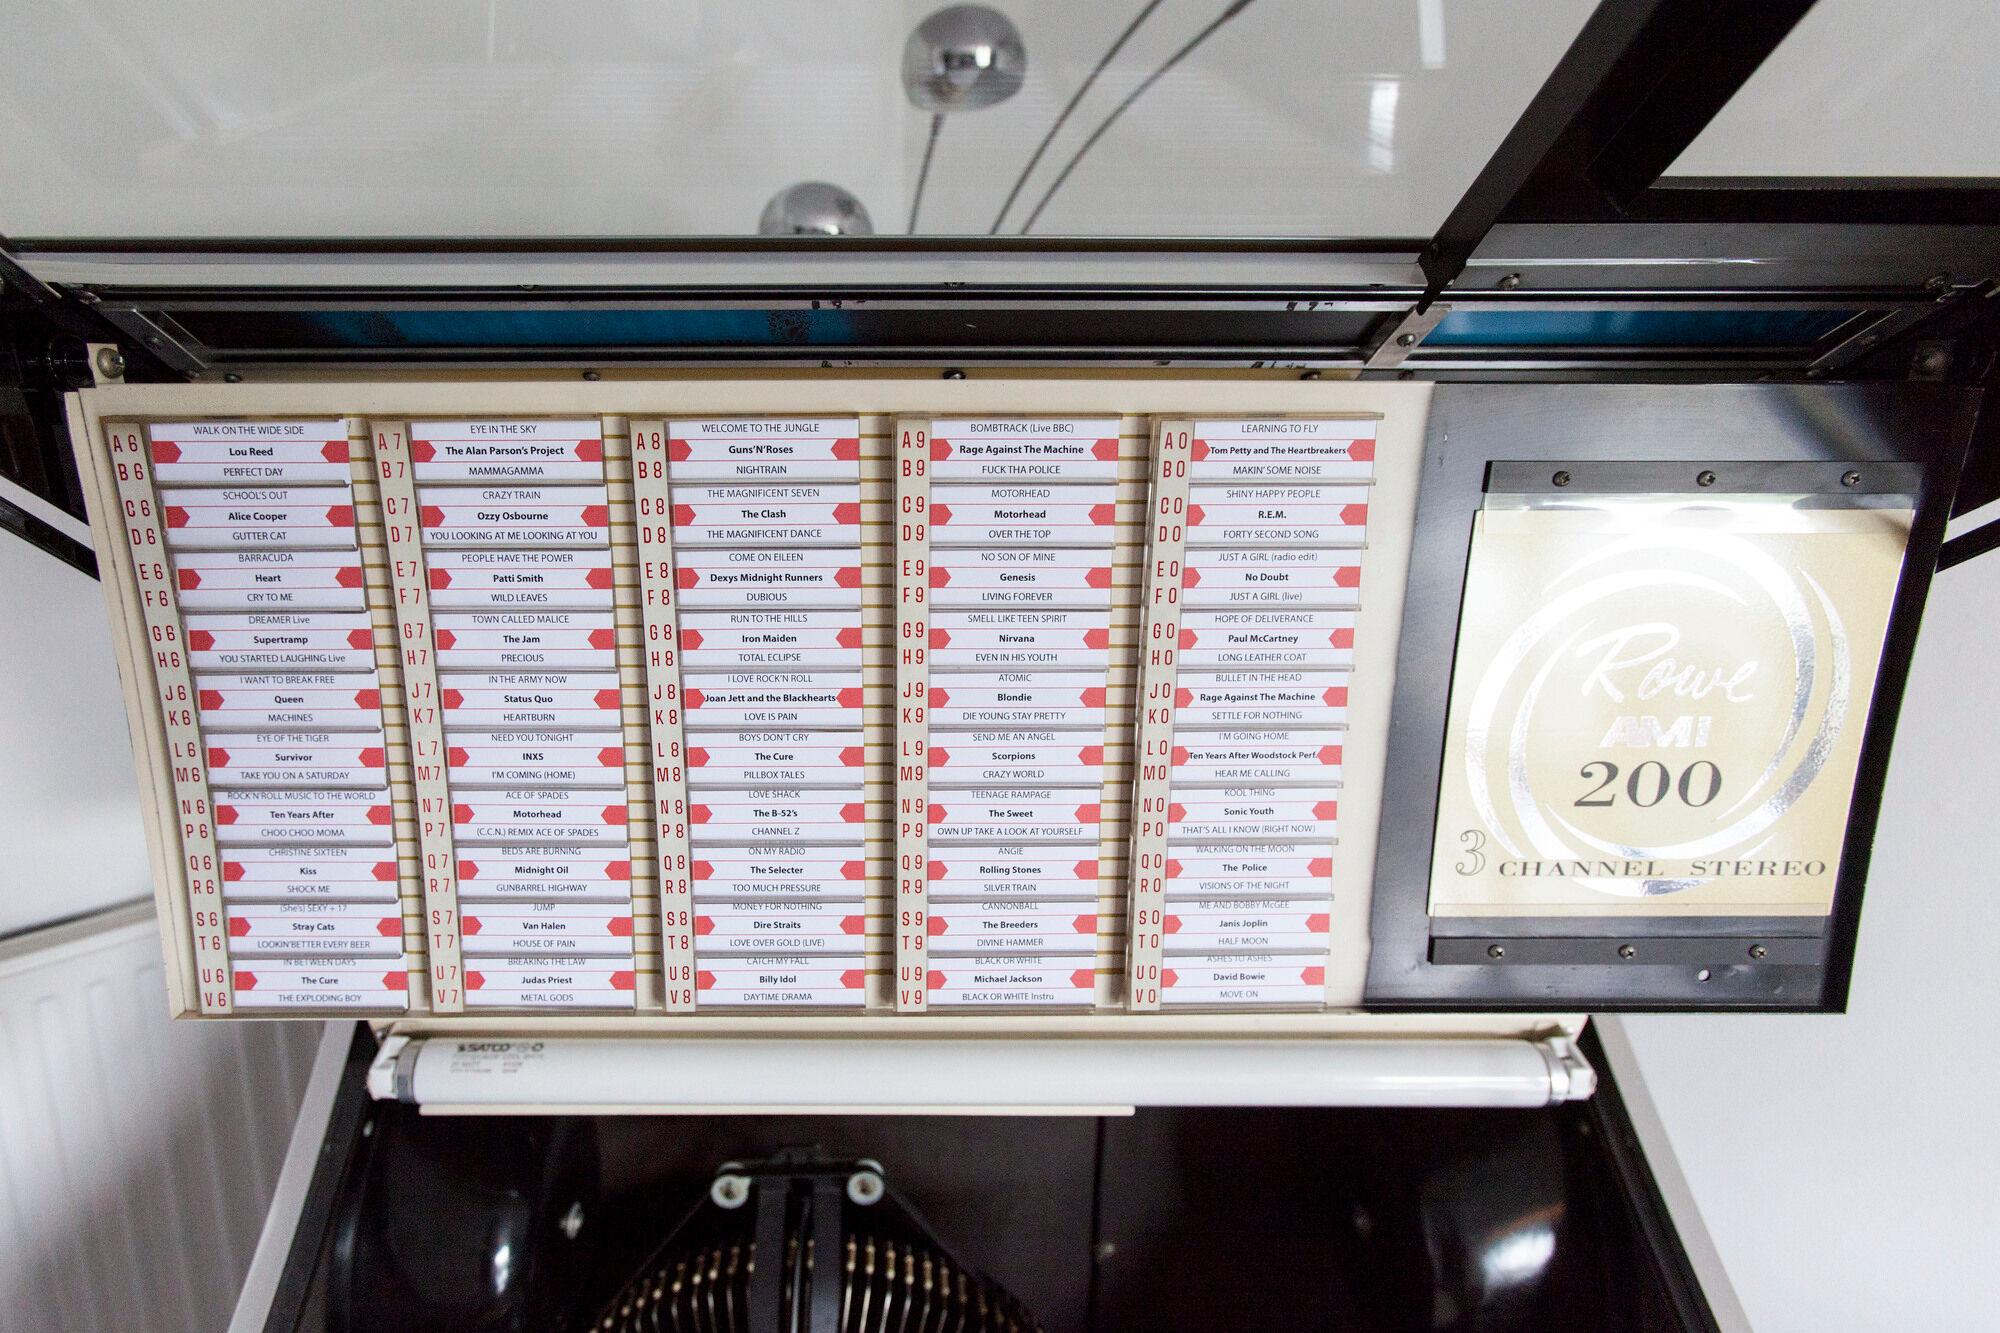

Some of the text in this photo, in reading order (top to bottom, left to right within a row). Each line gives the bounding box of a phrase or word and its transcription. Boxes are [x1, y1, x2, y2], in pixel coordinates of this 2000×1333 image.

[970, 423, 1028, 433] BOMBTRACK
[229, 447, 274, 456] Lou Reed
[445, 446, 464, 455] The
[465, 446, 487, 455] Alan
[530, 446, 564, 457] Project
[959, 444, 1084, 456] Rage Against The Machine
[1210, 446, 1346, 456] Tom Petty and The Heartbreakers
[223, 467, 283, 477] PERFECT DAY
[468, 466, 544, 476] MAMMAGAMMA
[736, 465, 787, 475] NIGHTRAIN
[268, 491, 288, 500] OUT
[482, 490, 541, 500] CRAZY TRAIN
[707, 488, 820, 498] THE MAGNIFICENT SEVEN
[991, 489, 1051, 498] MOTORHEAD
[1226, 489, 1321, 499] SHINY HAPPY PEOPLE
[228, 511, 287, 523] Alice Cooper
[477, 511, 549, 522] Ozzy Osbourne
[741, 509, 787, 519] The Clash
[994, 509, 1046, 519] Motorhead
[238, 553, 294, 563] BARRACUDA
[255, 574, 282, 583] Heart
[493, 574, 544, 583] Patti Smith
[710, 573, 823, 584] Dexys Midnight Runners
[999, 573, 1036, 582] Genesis
[1245, 572, 1289, 582] No Doubt
[746, 592, 788, 602] DUBIOUS
[982, 592, 1053, 601] LIVING FOREVER
[1214, 614, 1314, 623] HOPE OF DELIVERANCE
[253, 635, 309, 646] Supertramp
[502, 635, 541, 644] The Jam
[742, 634, 797, 643] Iron Maiden
[999, 634, 1035, 643] Nirvana
[1228, 634, 1299, 645] Paul McCartney
[501, 653, 545, 663] PRECIOUS
[738, 653, 801, 662] TOTAL ECLIPSE
[1577, 622, 1758, 703] Rowe
[998, 674, 1032, 682] ATOMIC
[274, 695, 304, 705] Queen
[504, 694, 553, 704] Status Quo
[704, 693, 836, 703] Joan Jett and the Blackhearts
[997, 693, 1032, 702] Blondie
[1199, 692, 1316, 703] Rage Against The Machine
[268, 713, 314, 722] MACHINES
[503, 713, 556, 722] HEARTBURN
[1600, 715, 1712, 747] AMI
[274, 753, 313, 762] Survivor
[522, 752, 544, 761] INXS
[754, 752, 794, 761] The Cure
[992, 751, 1036, 762] Scorpions
[1189, 751, 1204, 760] Ten
[1205, 752, 1227, 760] Years
[1228, 751, 1250, 759] After
[982, 770, 1045, 779] CRAZY WORLD
[1574, 760, 1722, 807] 200
[269, 810, 335, 819] Ten Years After
[513, 810, 562, 818] Motorhead
[753, 809, 770, 818] The
[988, 809, 1033, 818] The Sweet
[1224, 807, 1274, 816] Sonic Youth
[1455, 829, 1826, 878] 3 CHANNEL STEREO
[299, 867, 317, 875] Kiss
[514, 865, 569, 876] Midnight Oil
[750, 866, 804, 874] The Selecter
[979, 865, 1042, 876] Rolling Stones
[1222, 863, 1268, 872] The Police
[496, 884, 588, 892] GUNBARREL HIGHWAY
[292, 922, 335, 933] Stray Cats
[540, 922, 566, 930] Halen
[753, 921, 801, 929] Dire Straits
[1000, 920, 1039, 929] Breeders
[1218, 919, 1268, 929] Janis Joplin
[301, 976, 339, 985] The Cure
[521, 976, 547, 984] Judas
[759, 975, 797, 985] Billy Idol
[974, 974, 1043, 983] Michael Jackson
[1213, 972, 1266, 981] David Bowie
[743, 993, 813, 1001] DAYTIME DRAMA
